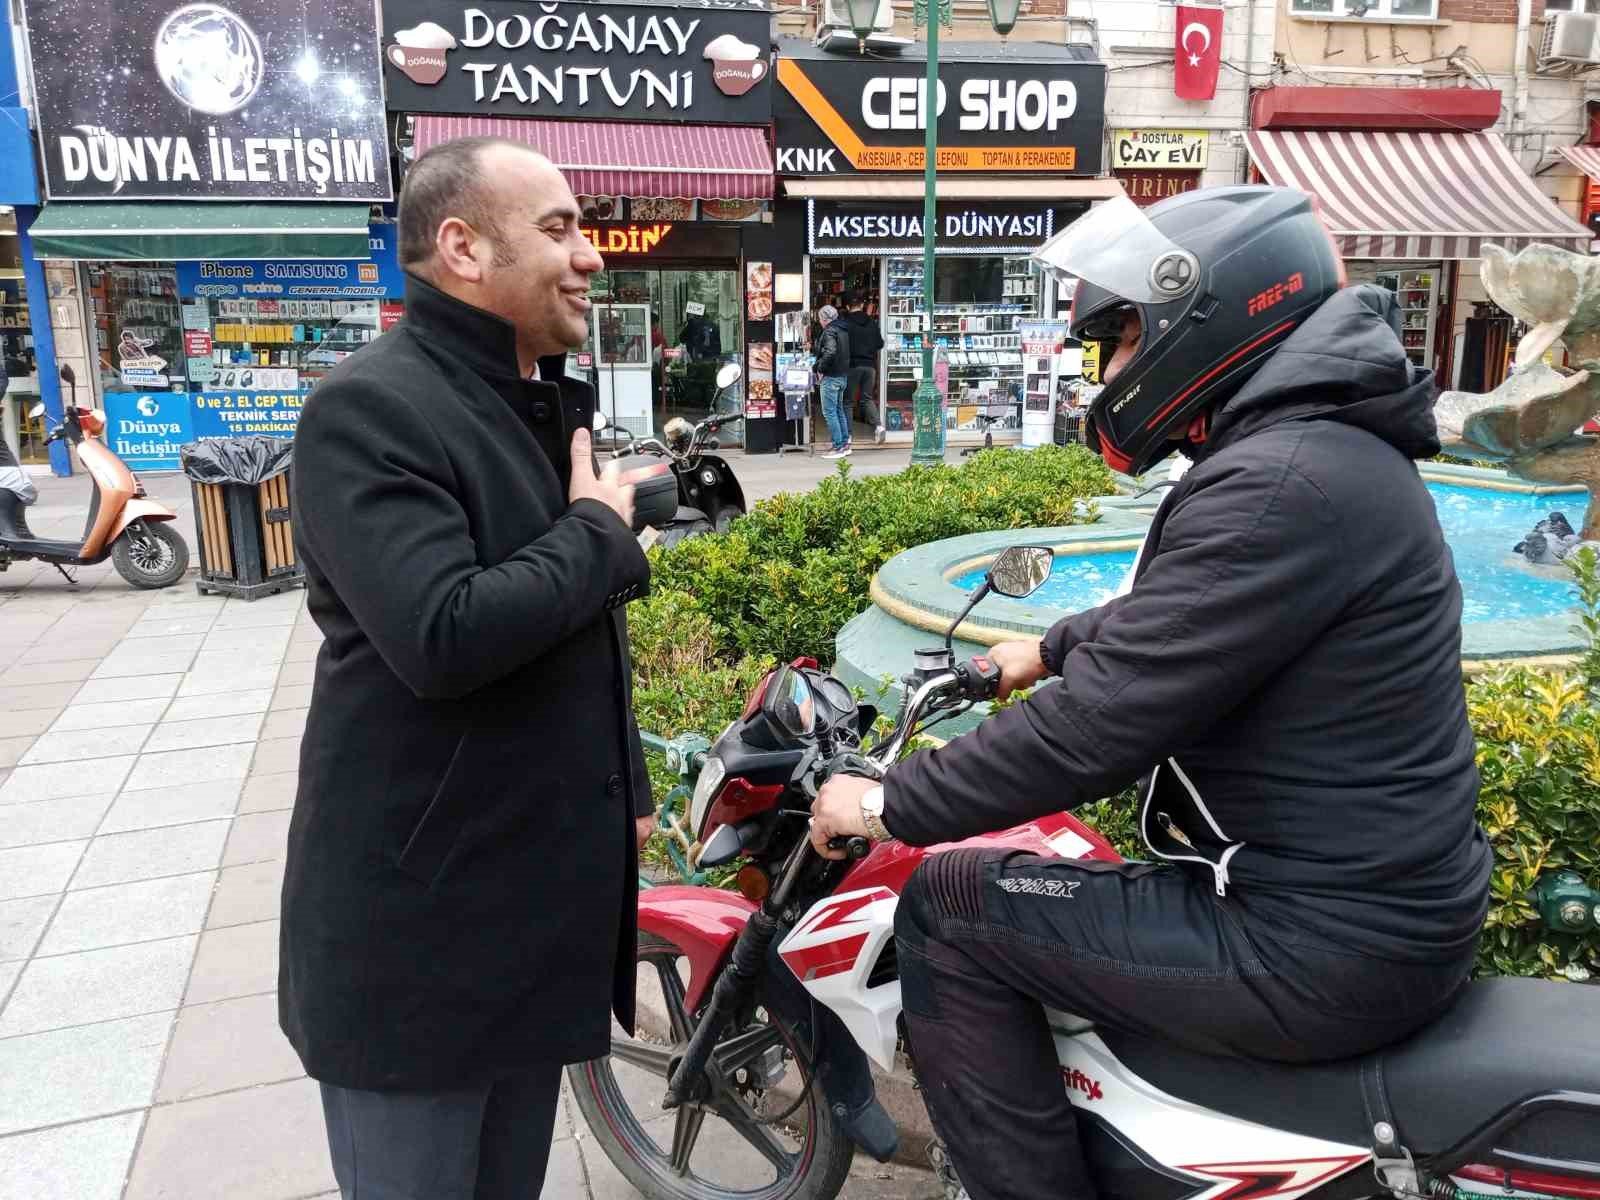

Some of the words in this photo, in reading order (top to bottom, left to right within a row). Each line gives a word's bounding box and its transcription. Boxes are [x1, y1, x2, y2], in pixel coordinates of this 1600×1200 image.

[460, 2, 700, 55] DOĞANAY
[861, 77, 947, 130] CEP
[960, 80, 1077, 131] SHOP
[1141, 133, 1184, 144] DOSTLAR
[59, 127, 200, 183] DÜNYA
[208, 126, 376, 194] İLETİŞİM
[776, 147, 837, 173] KNK
[857, 151, 902, 166] AKSESUAR
[936, 152, 968, 166] LEFONU
[982, 152, 1014, 165] TOPTAN
[1015, 152, 1021, 165] &
[1022, 152, 1071, 166] PERAKENDE
[1119, 138, 1160, 166] ÇAY
[1168, 139, 1202, 163] EVİ
[818, 216, 938, 238] AKSESUA
[945, 211, 1043, 237] DÜNYASI
[200, 262, 254, 278] iPhone
[264, 263, 348, 279] SAMSUNG
[242, 282, 284, 294] realme
[288, 286, 341, 296] GENERAL
[342, 286, 388, 296] MOBILE
[207, 398, 221, 408] ve
[224, 396, 235, 408] 2.
[237, 396, 252, 408] EL
[255, 395, 279, 408] CEP
[219, 409, 269, 421] TEKNİK
[118, 419, 181, 437] Dünya
[228, 424, 243, 433] 15
